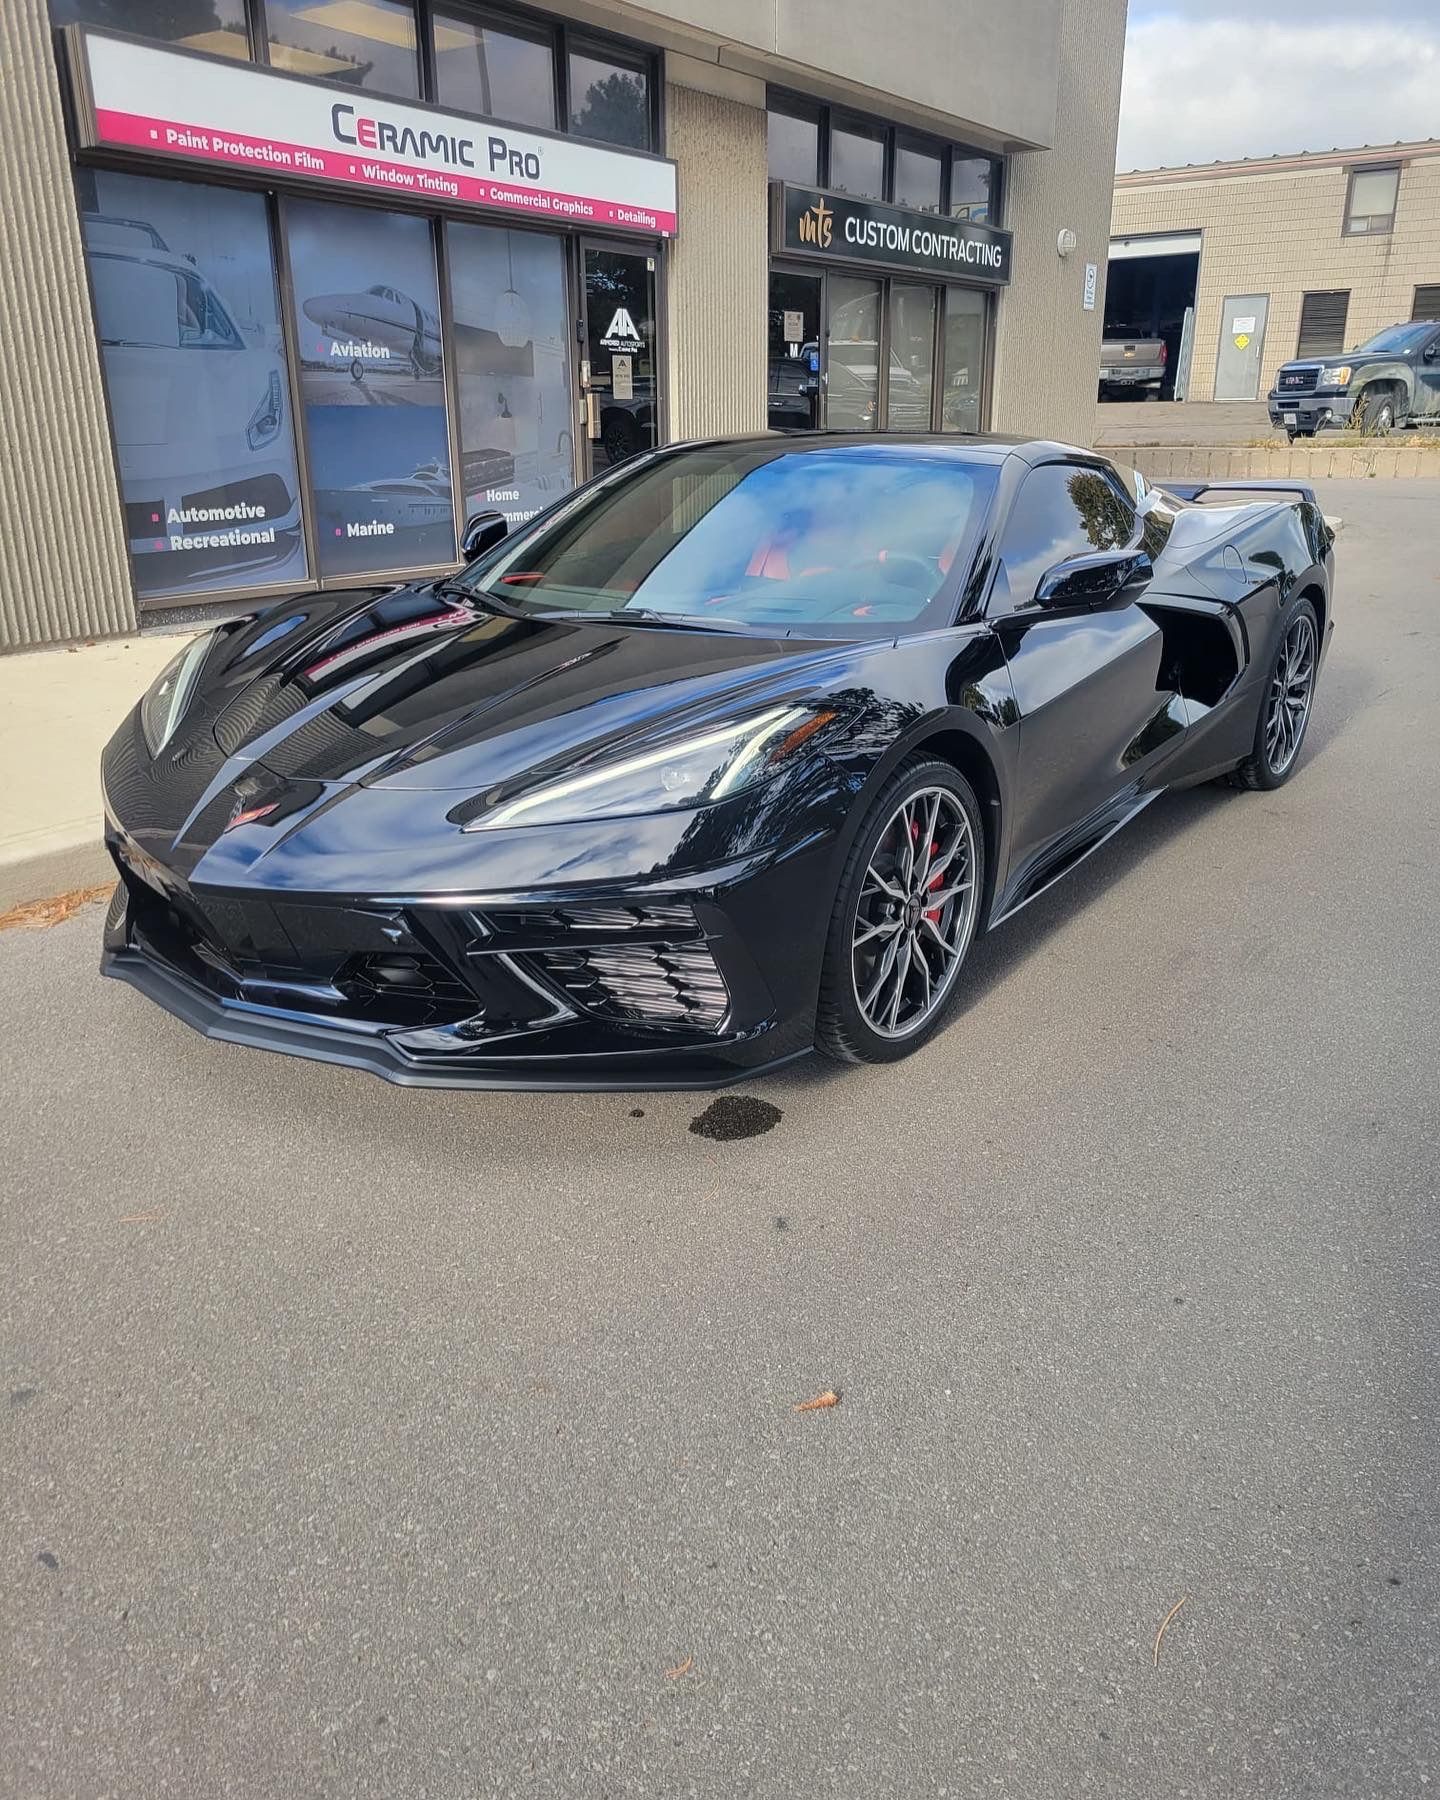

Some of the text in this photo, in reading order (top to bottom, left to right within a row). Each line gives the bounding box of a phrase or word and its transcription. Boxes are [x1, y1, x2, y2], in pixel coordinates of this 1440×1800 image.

[332, 103, 474, 167] CERAMIC
[167, 129, 324, 171] Paint Protection Film
[362, 164, 458, 196] Window Tinting
[490, 187, 593, 215] Commercial Graphics
[617, 209, 656, 228] Detailing
[845, 217, 1002, 267] CUSTOM CONTRACTING
[330, 342, 390, 359] Aviation
[486, 489, 520, 502] Home
[167, 502, 266, 524] Automotive
[170, 528, 275, 550] Recreational
[346, 520, 395, 536] Marine
